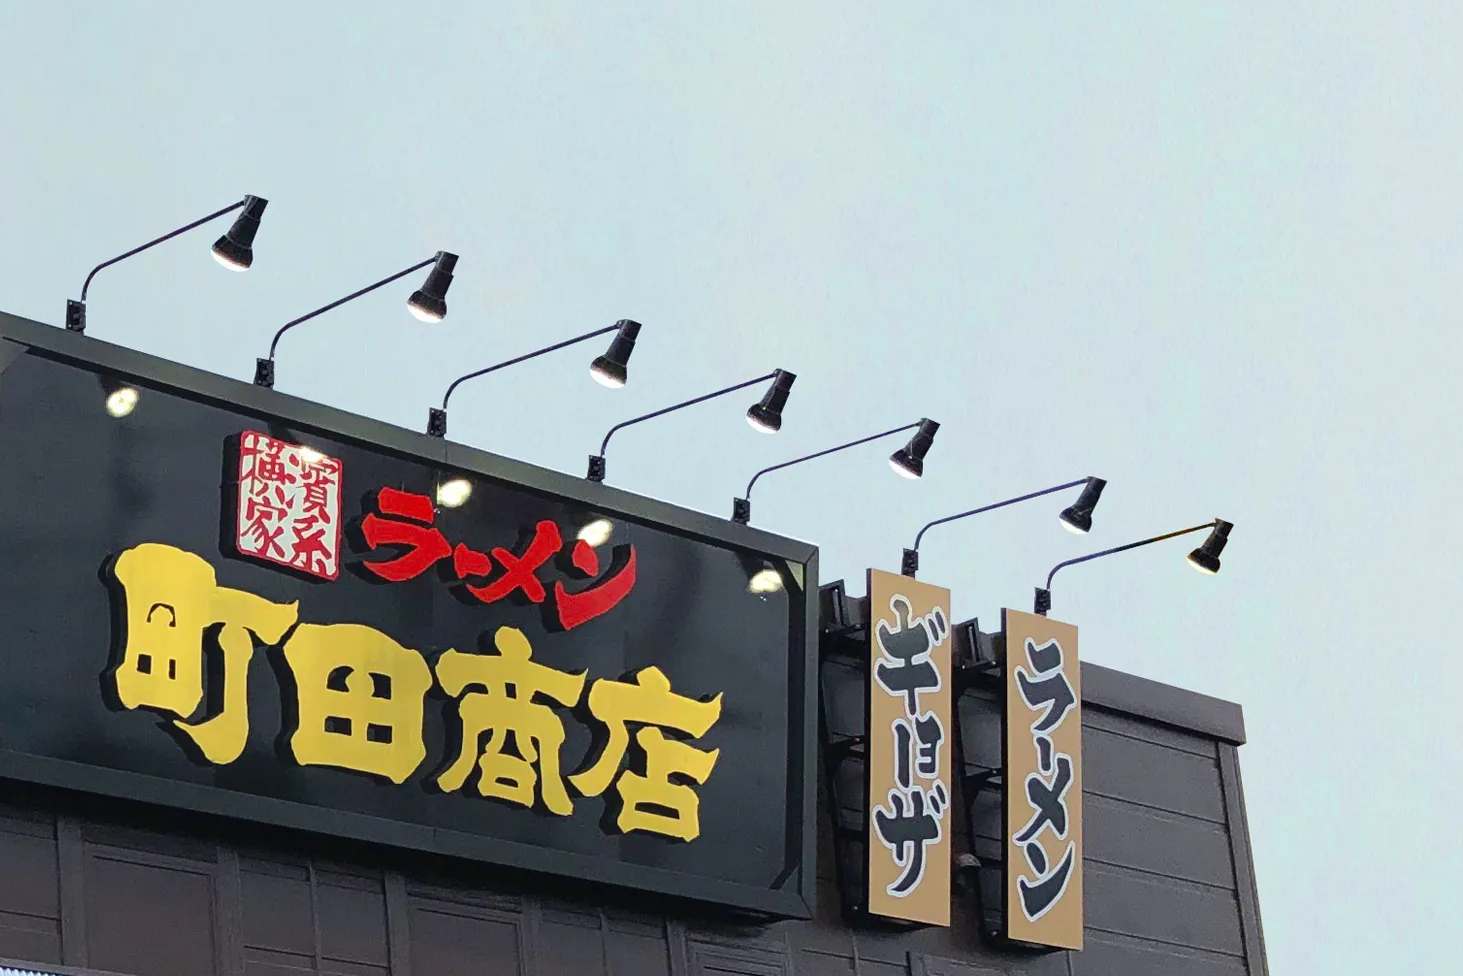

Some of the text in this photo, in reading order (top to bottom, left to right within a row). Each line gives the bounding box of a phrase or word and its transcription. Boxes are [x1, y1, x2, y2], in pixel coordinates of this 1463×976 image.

[115, 542, 724, 843] 町田商店
[361, 487, 637, 630] ラーメン
[873, 594, 950, 897] ギョーザ
[1013, 637, 1077, 922] ラーメン
